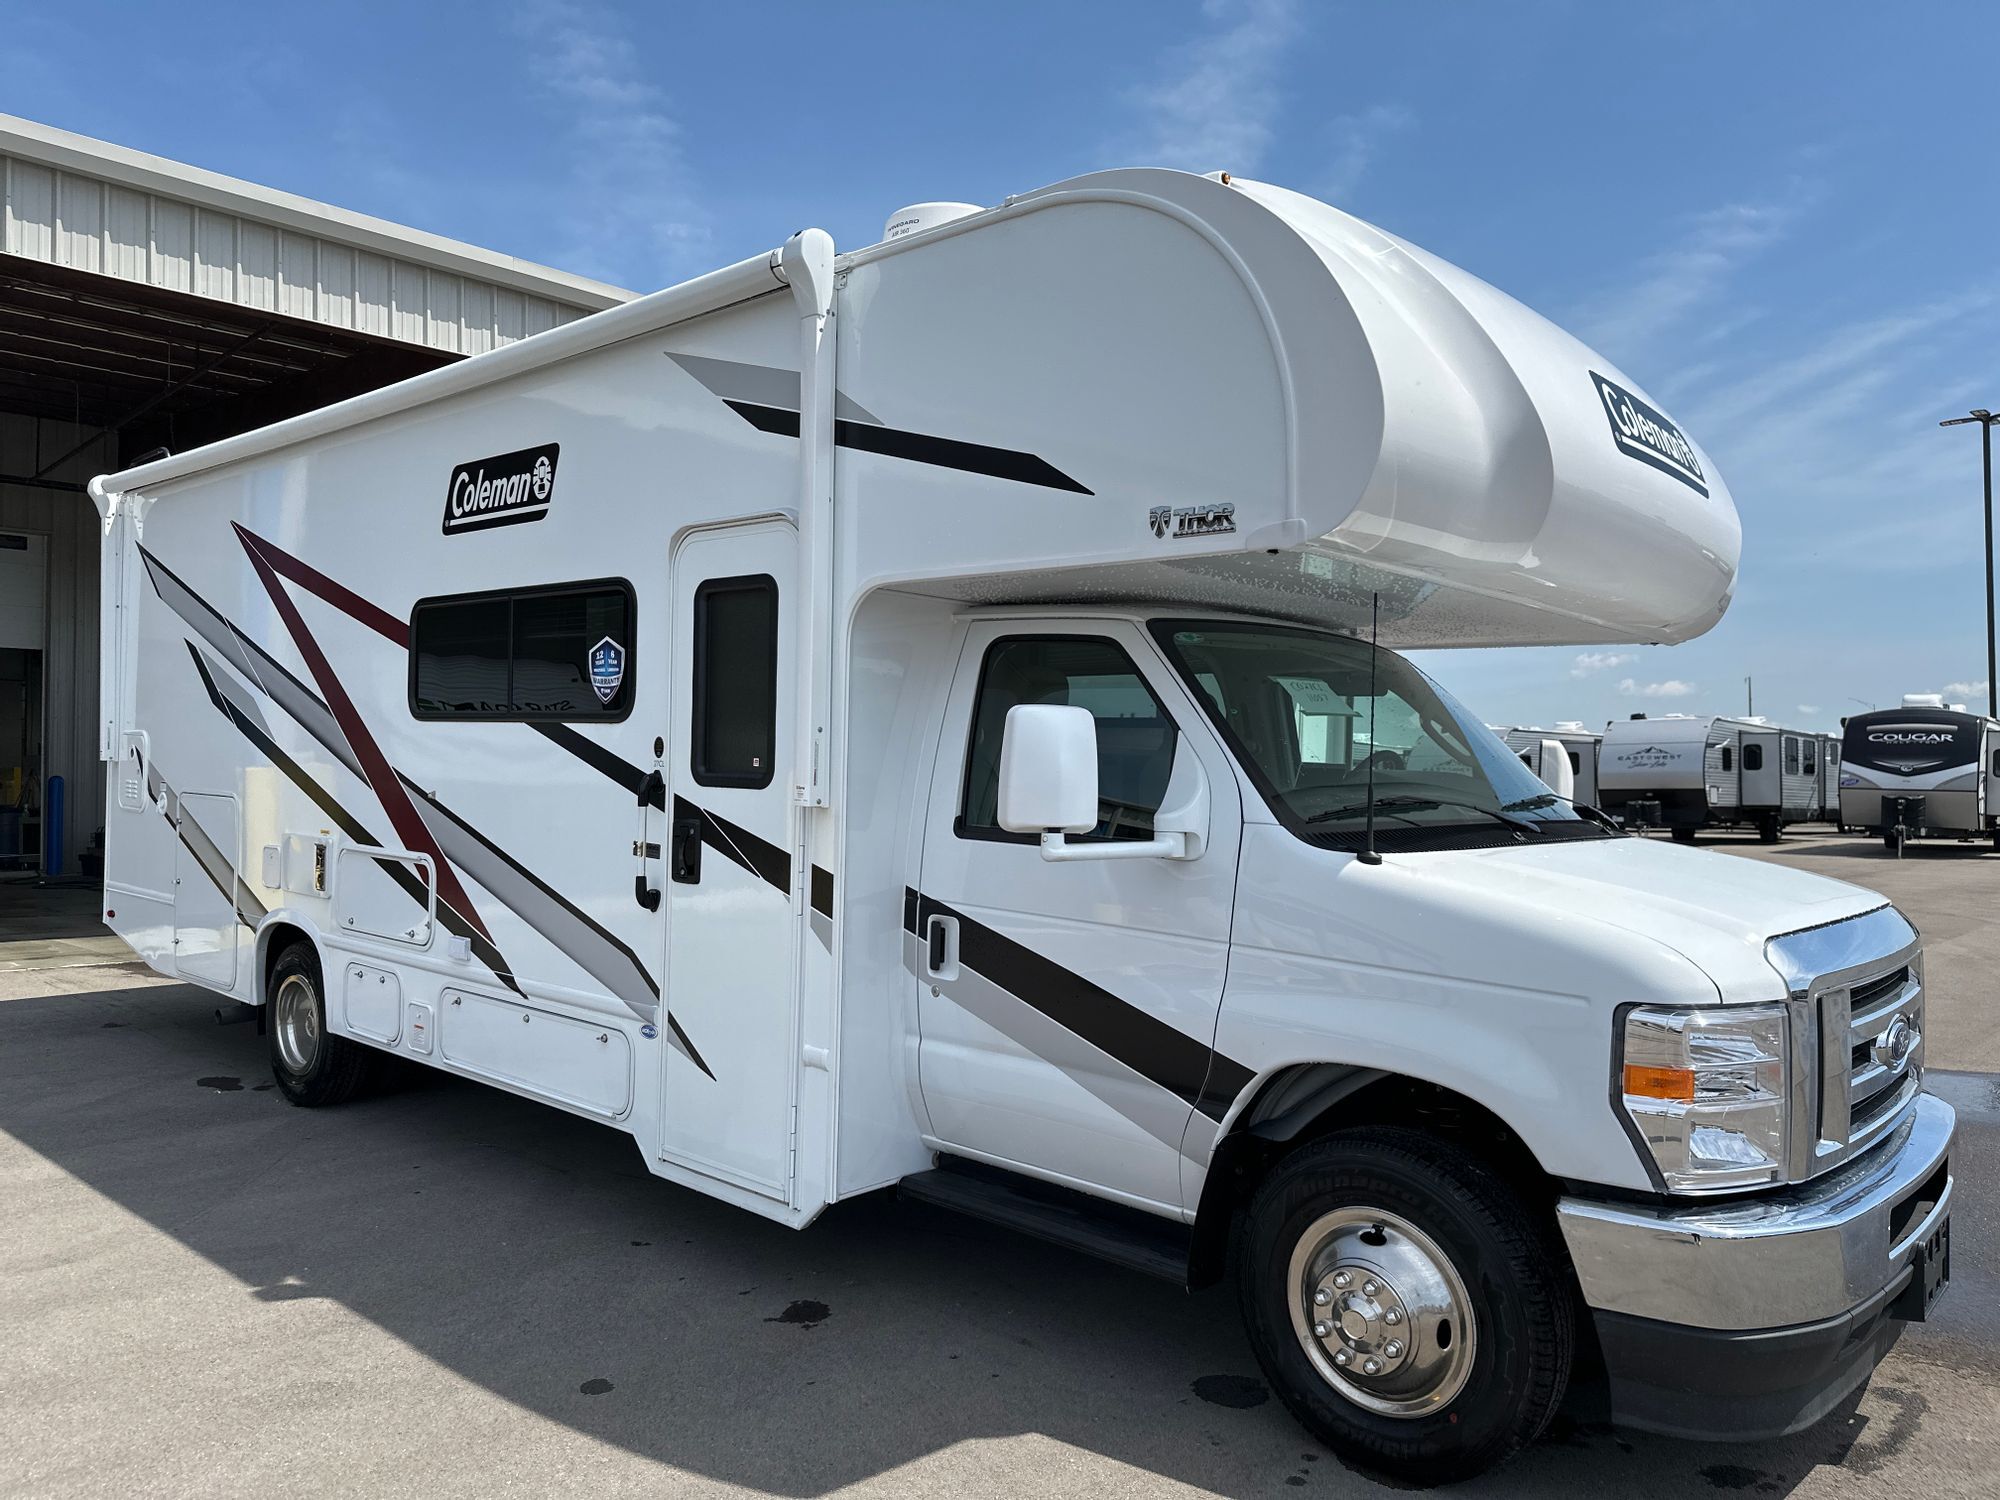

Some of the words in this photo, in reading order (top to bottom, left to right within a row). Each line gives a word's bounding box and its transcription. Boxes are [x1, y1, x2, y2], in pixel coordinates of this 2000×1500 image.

[1601, 382, 1690, 467] Coleman
[452, 468, 531, 517] Coleman
[1173, 502, 1236, 532] THOR
[592, 676, 620, 685] WARRANTY
[1868, 733, 1954, 742] COUGAR
